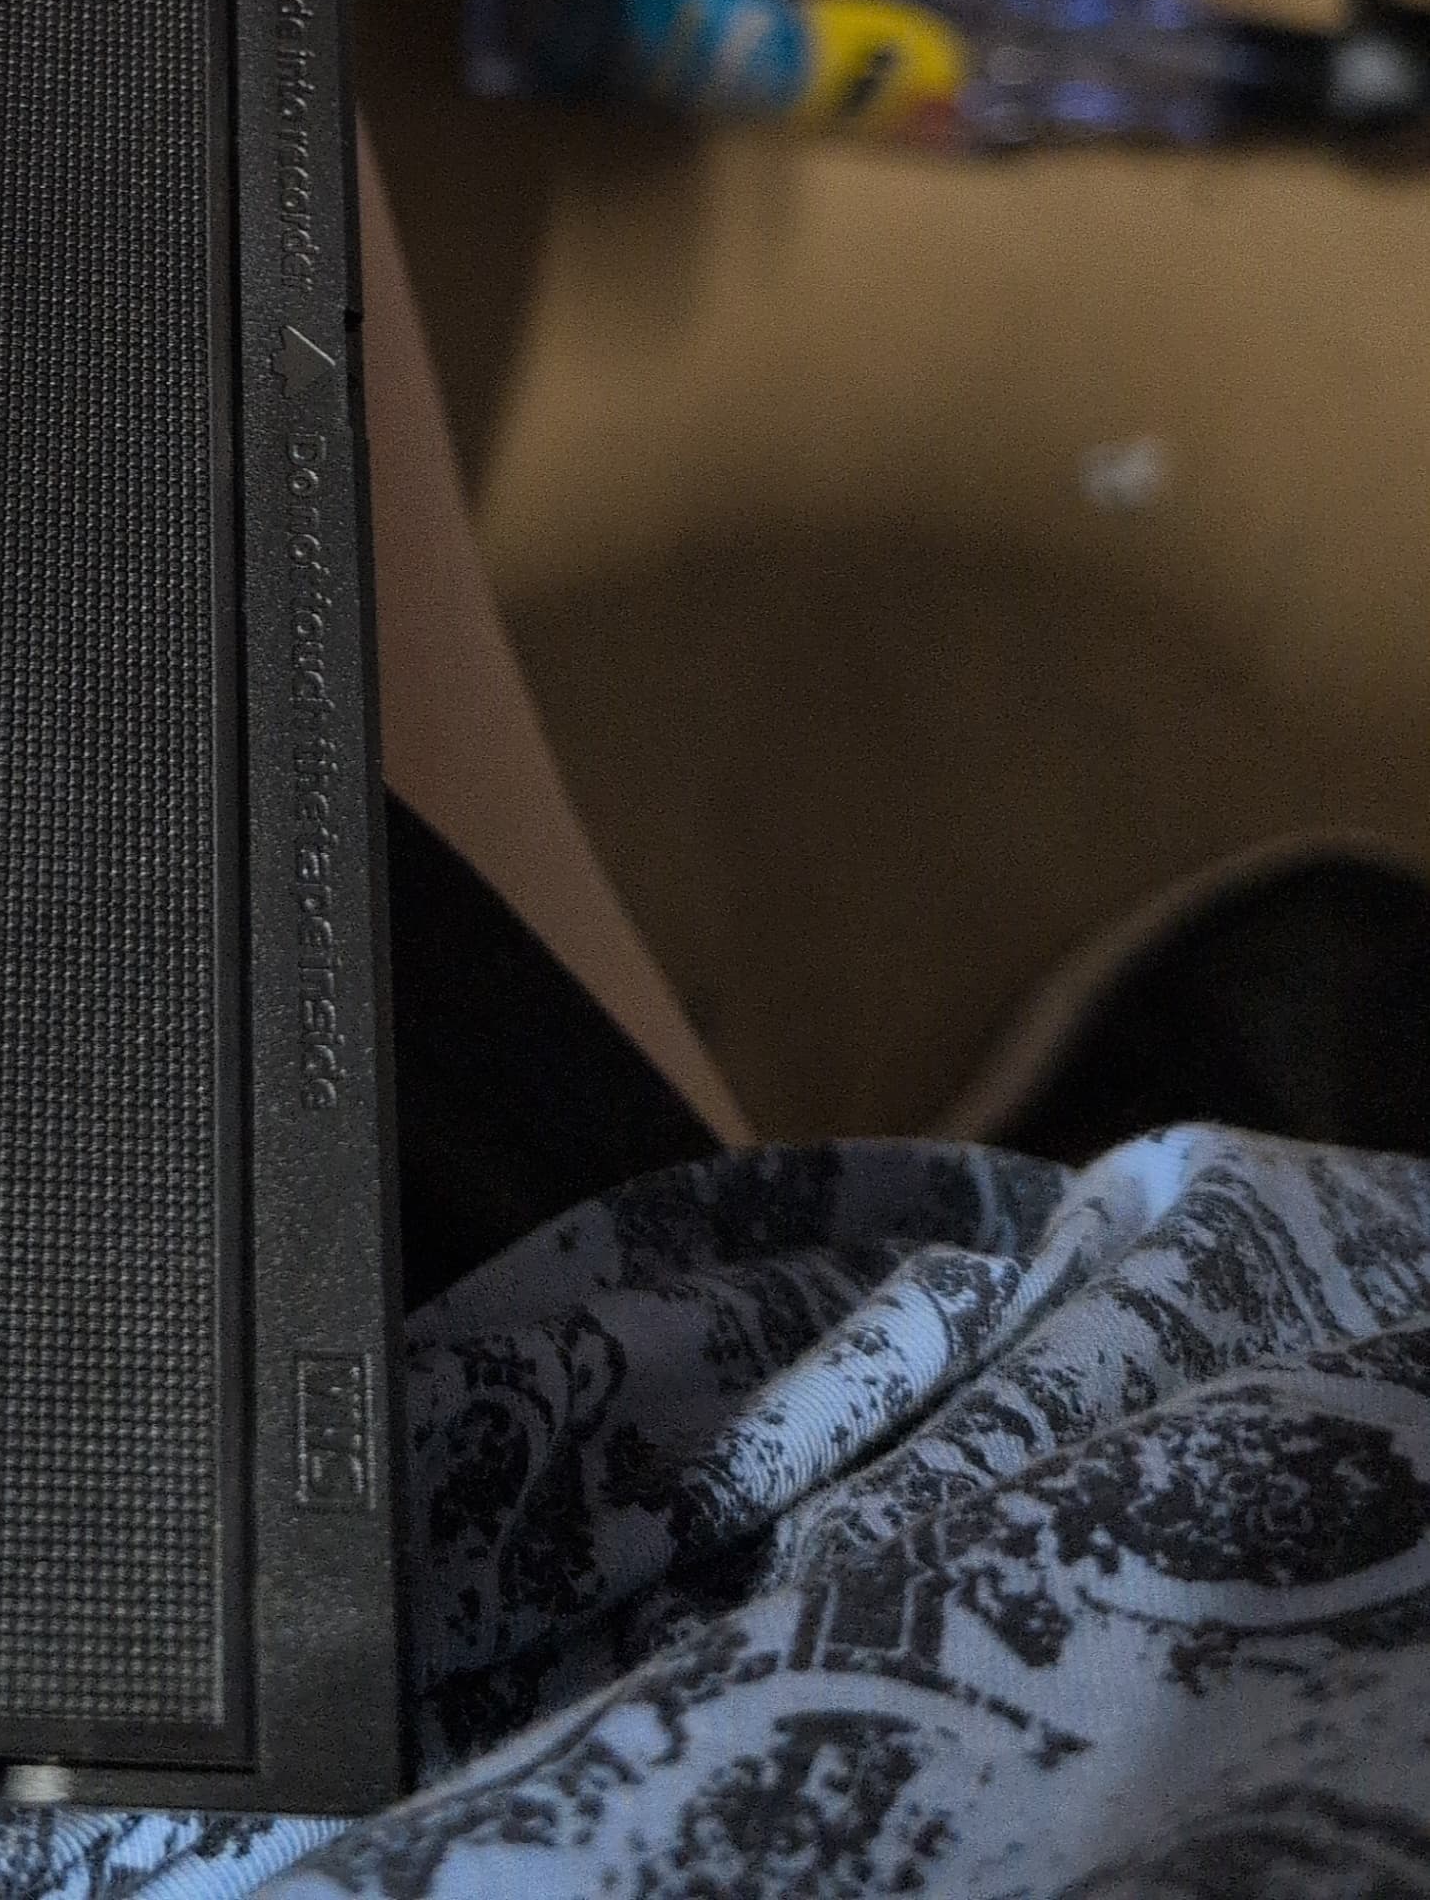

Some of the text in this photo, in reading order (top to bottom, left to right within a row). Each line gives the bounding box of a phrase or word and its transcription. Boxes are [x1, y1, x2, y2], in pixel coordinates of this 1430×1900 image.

[273, 48, 318, 118] into
[274, 128, 322, 292] recorder
[285, 435, 350, 1112] Do not touch the tape inside
